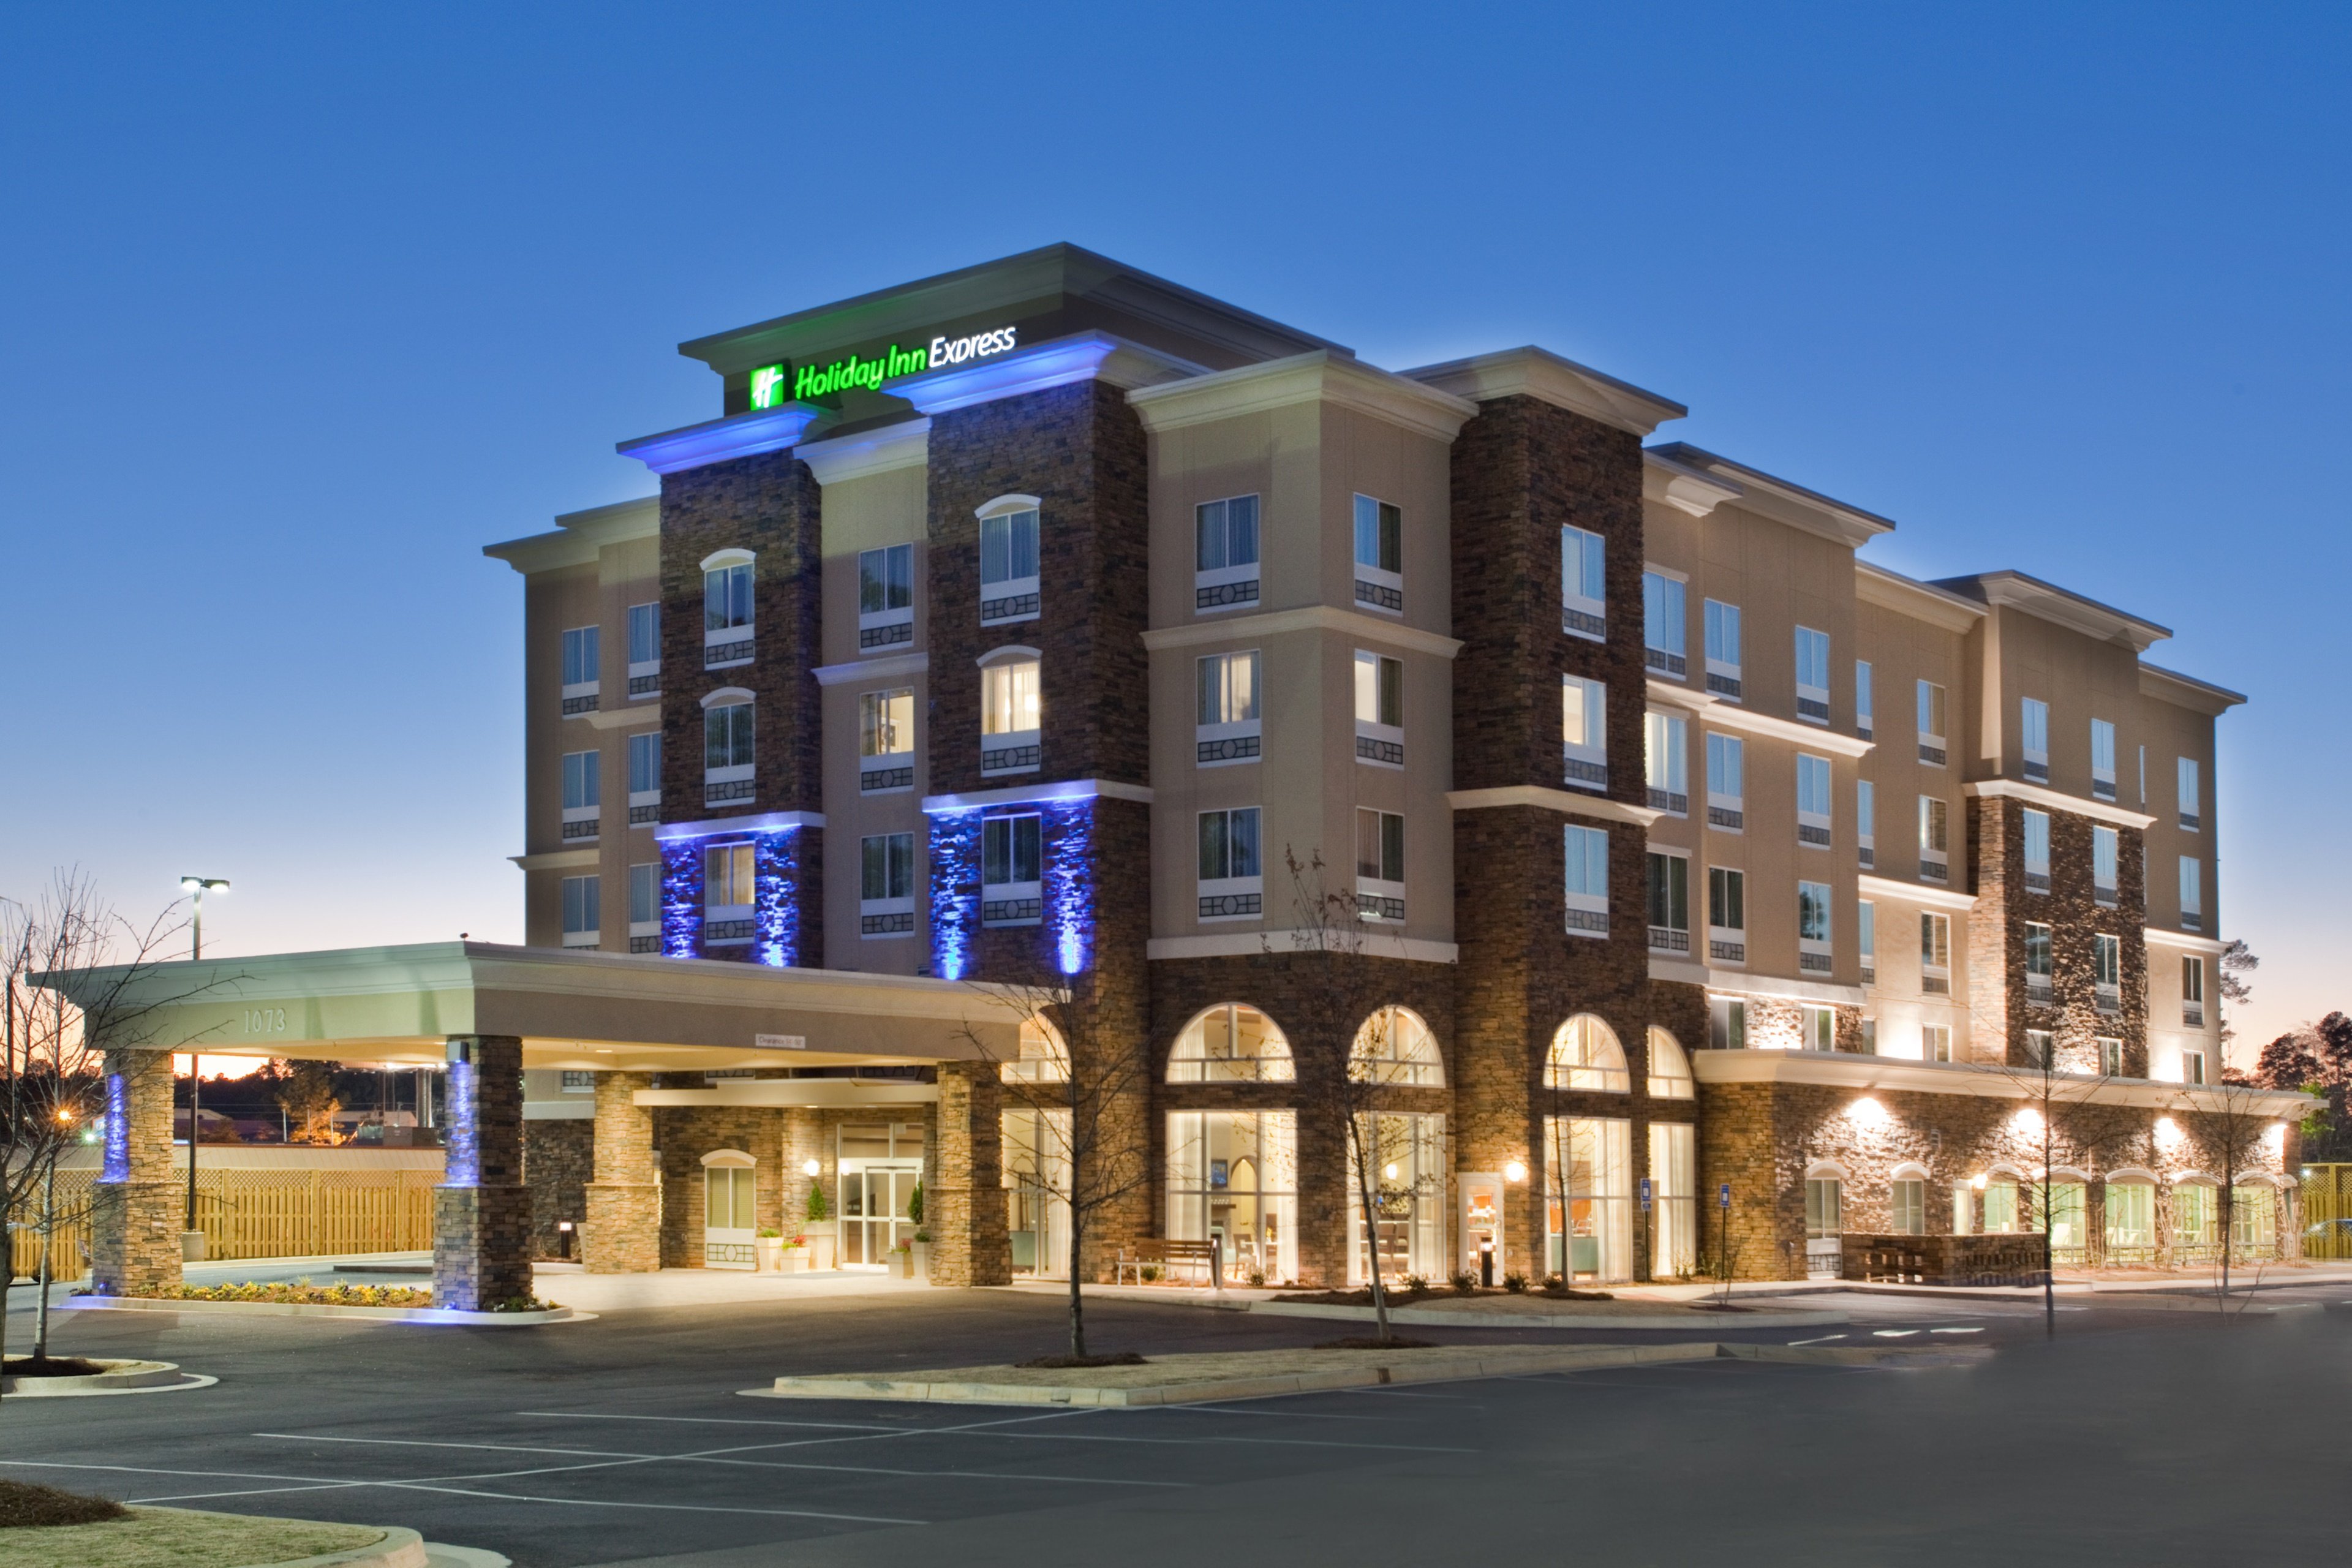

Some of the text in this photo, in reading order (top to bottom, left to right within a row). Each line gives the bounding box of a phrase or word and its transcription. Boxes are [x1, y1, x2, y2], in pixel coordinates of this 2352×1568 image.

[794, 326, 1016, 400] Holiday Inn Express
[244, 1008, 287, 1033] 1073
